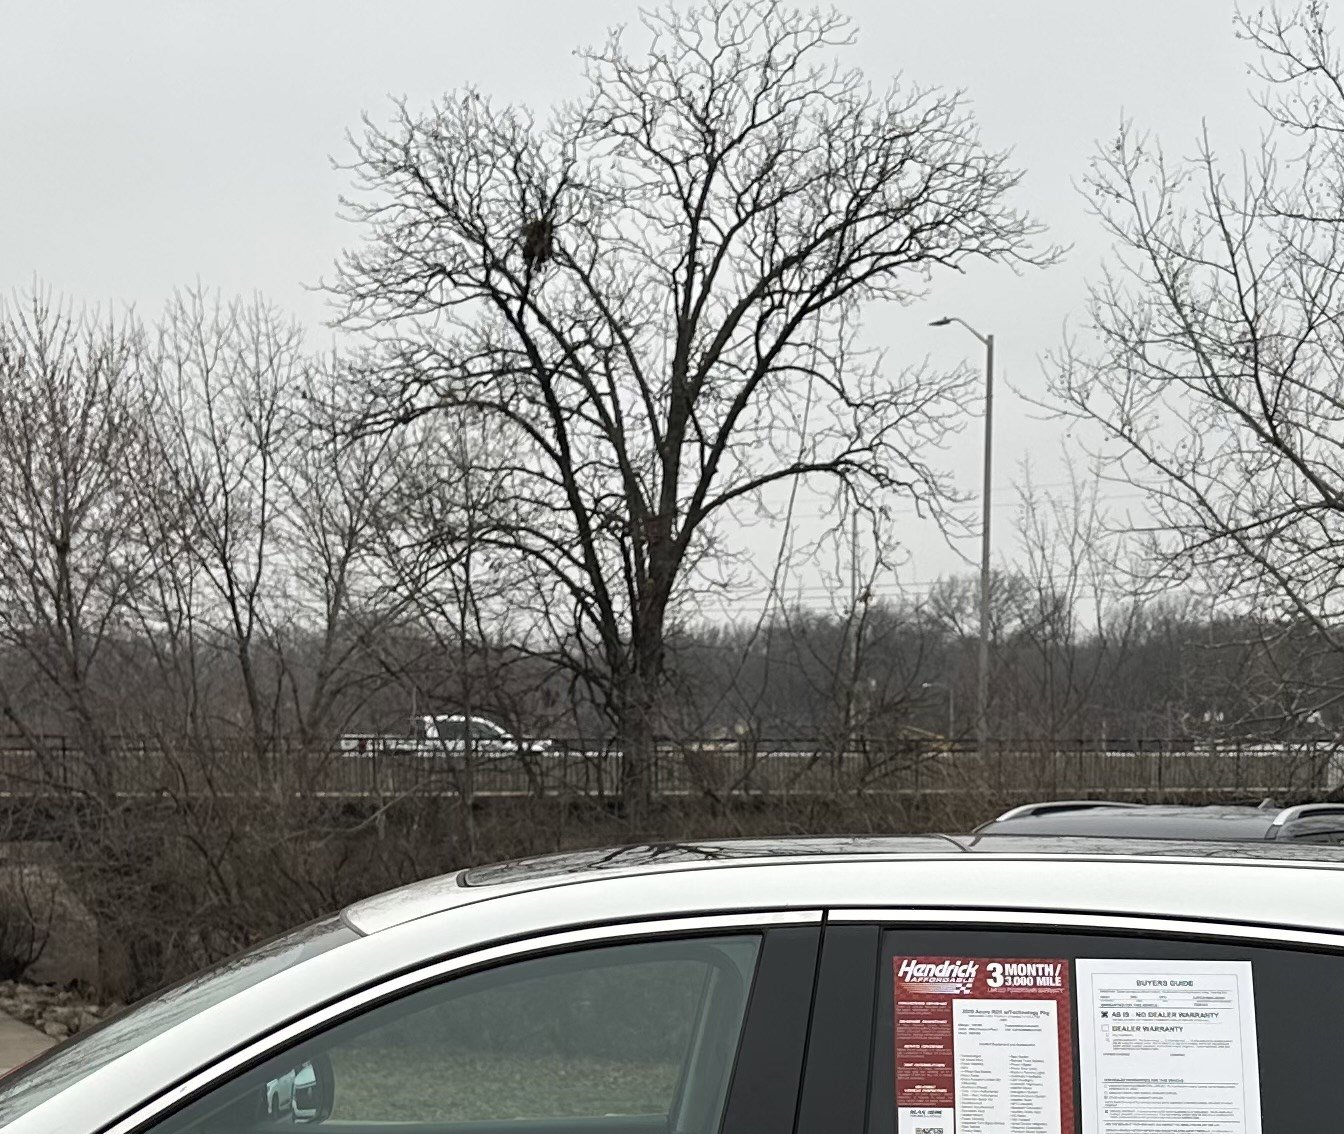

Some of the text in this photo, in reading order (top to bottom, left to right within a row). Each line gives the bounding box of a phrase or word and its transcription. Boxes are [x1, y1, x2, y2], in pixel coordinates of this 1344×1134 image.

[898, 960, 979, 982] Hendrick
[986, 963, 1004, 987] 3
[1005, 963, 1061, 977] MONTH/
[1036, 977, 1062, 987] MILE
